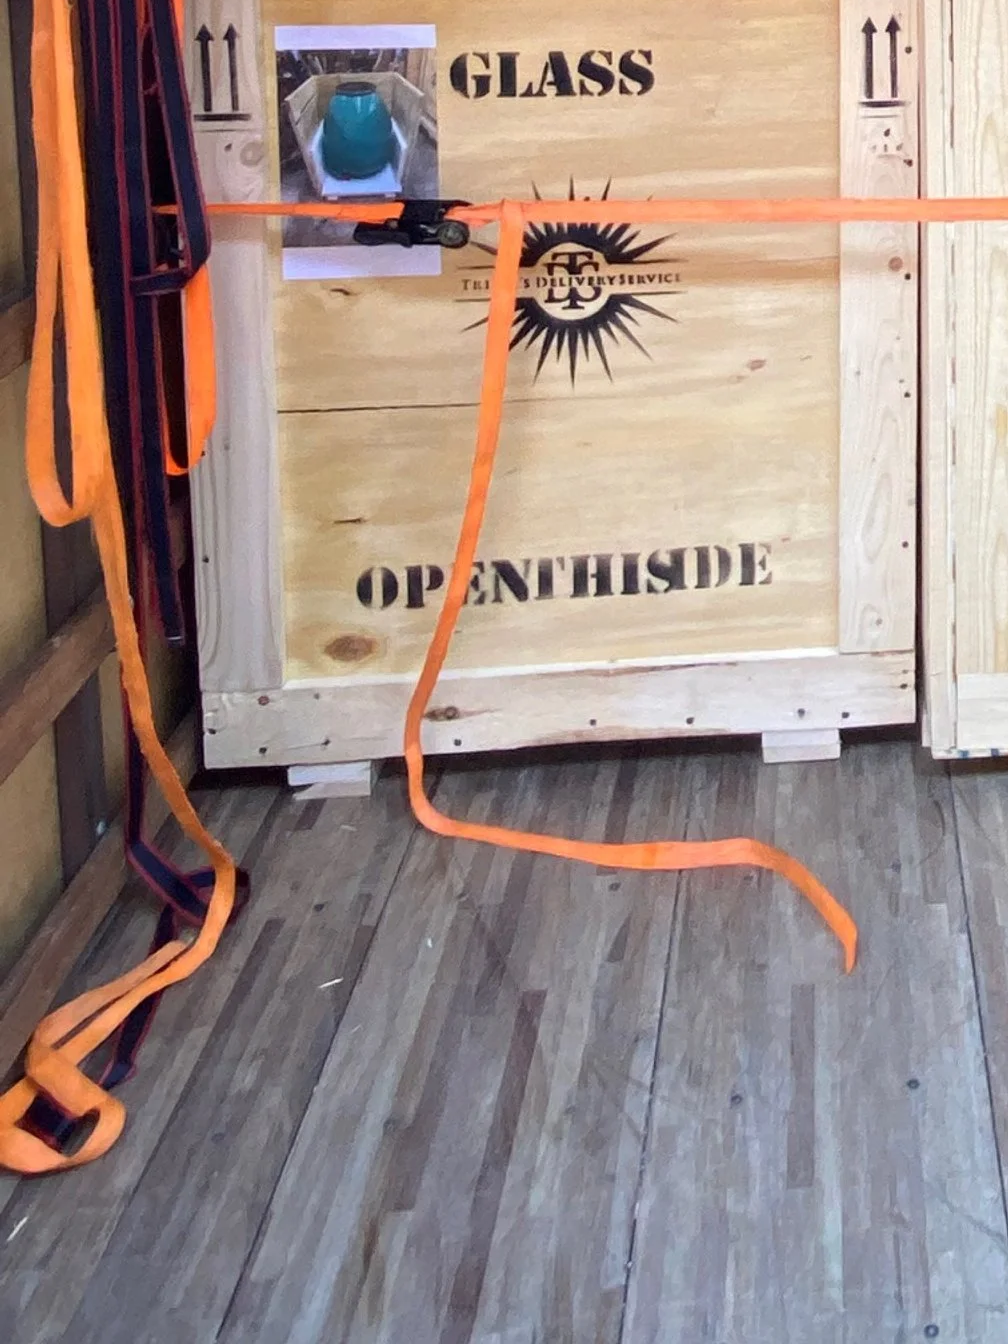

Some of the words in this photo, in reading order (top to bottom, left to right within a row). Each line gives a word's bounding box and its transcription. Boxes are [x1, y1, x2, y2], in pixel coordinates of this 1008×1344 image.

[449, 49, 655, 99] GLASS
[536, 275, 616, 289] DELIVERY
[619, 272, 683, 286] SERVICE
